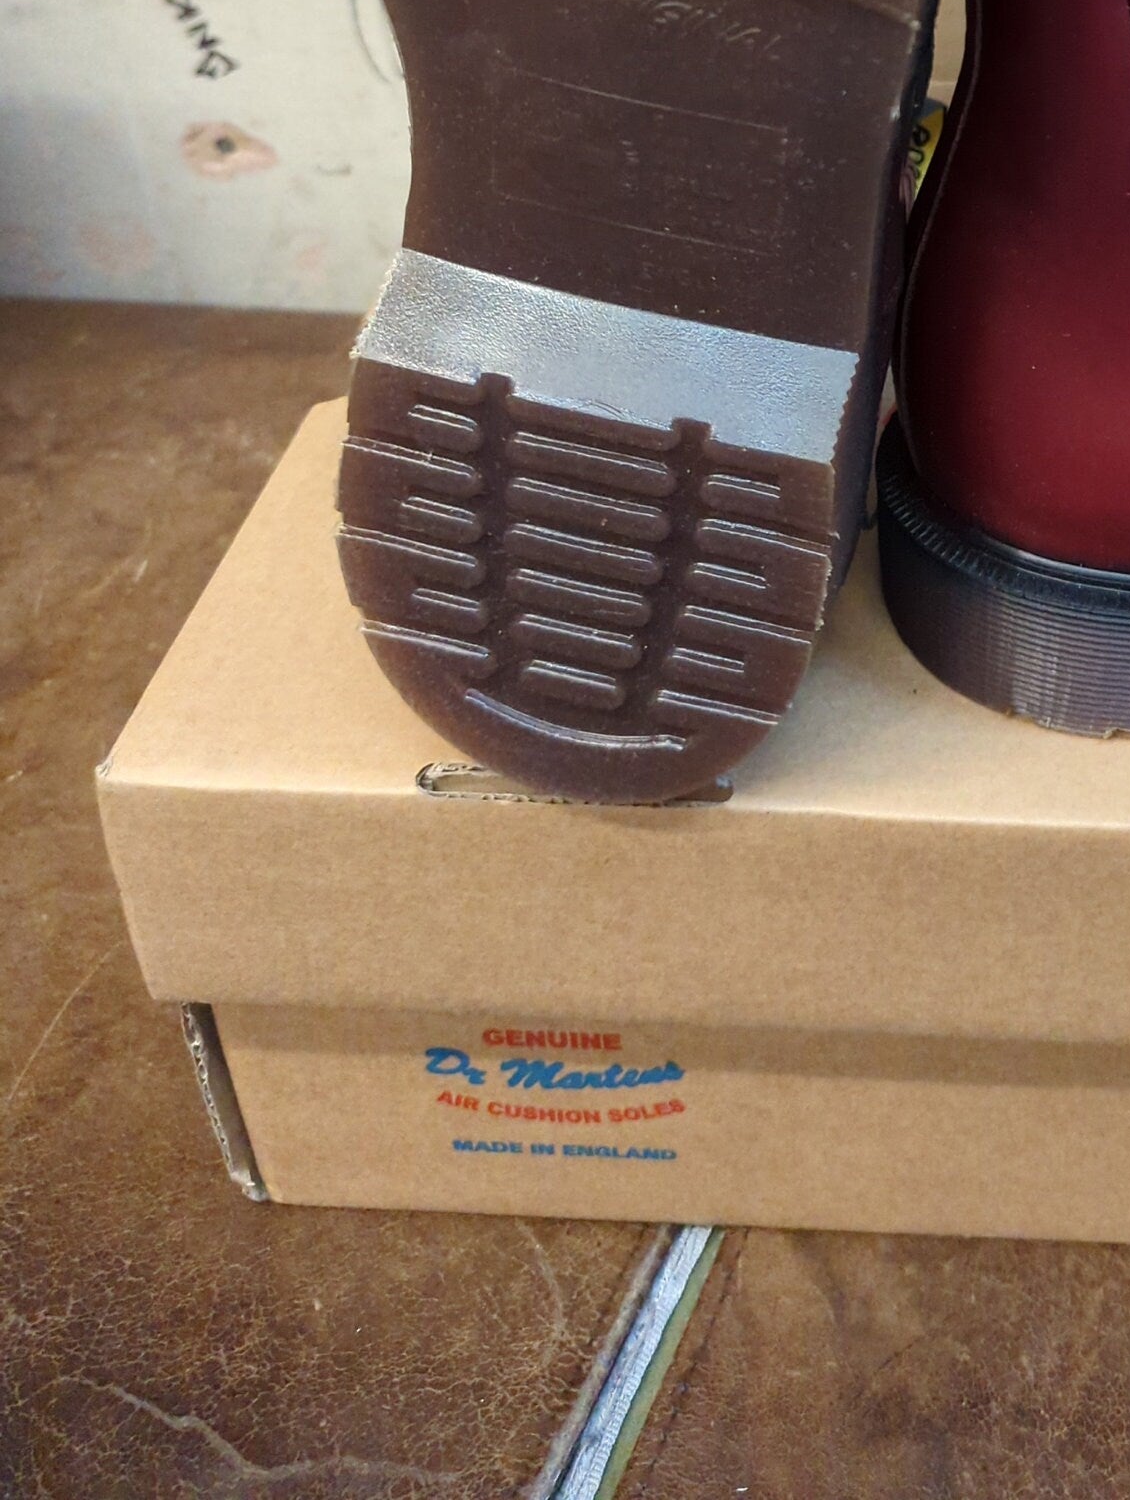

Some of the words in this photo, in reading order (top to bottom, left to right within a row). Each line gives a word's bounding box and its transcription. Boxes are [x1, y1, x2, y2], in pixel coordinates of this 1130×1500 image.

[482, 1027, 624, 1051] GENUINE
[500, 1057, 686, 1090] Martens
[436, 1090, 481, 1112] AIR
[487, 1100, 602, 1125] CUSHION
[607, 1098, 687, 1124] SOLES
[452, 1139, 525, 1154] MADE
[530, 1143, 556, 1156] IN
[562, 1144, 678, 1162] ENGLAND
